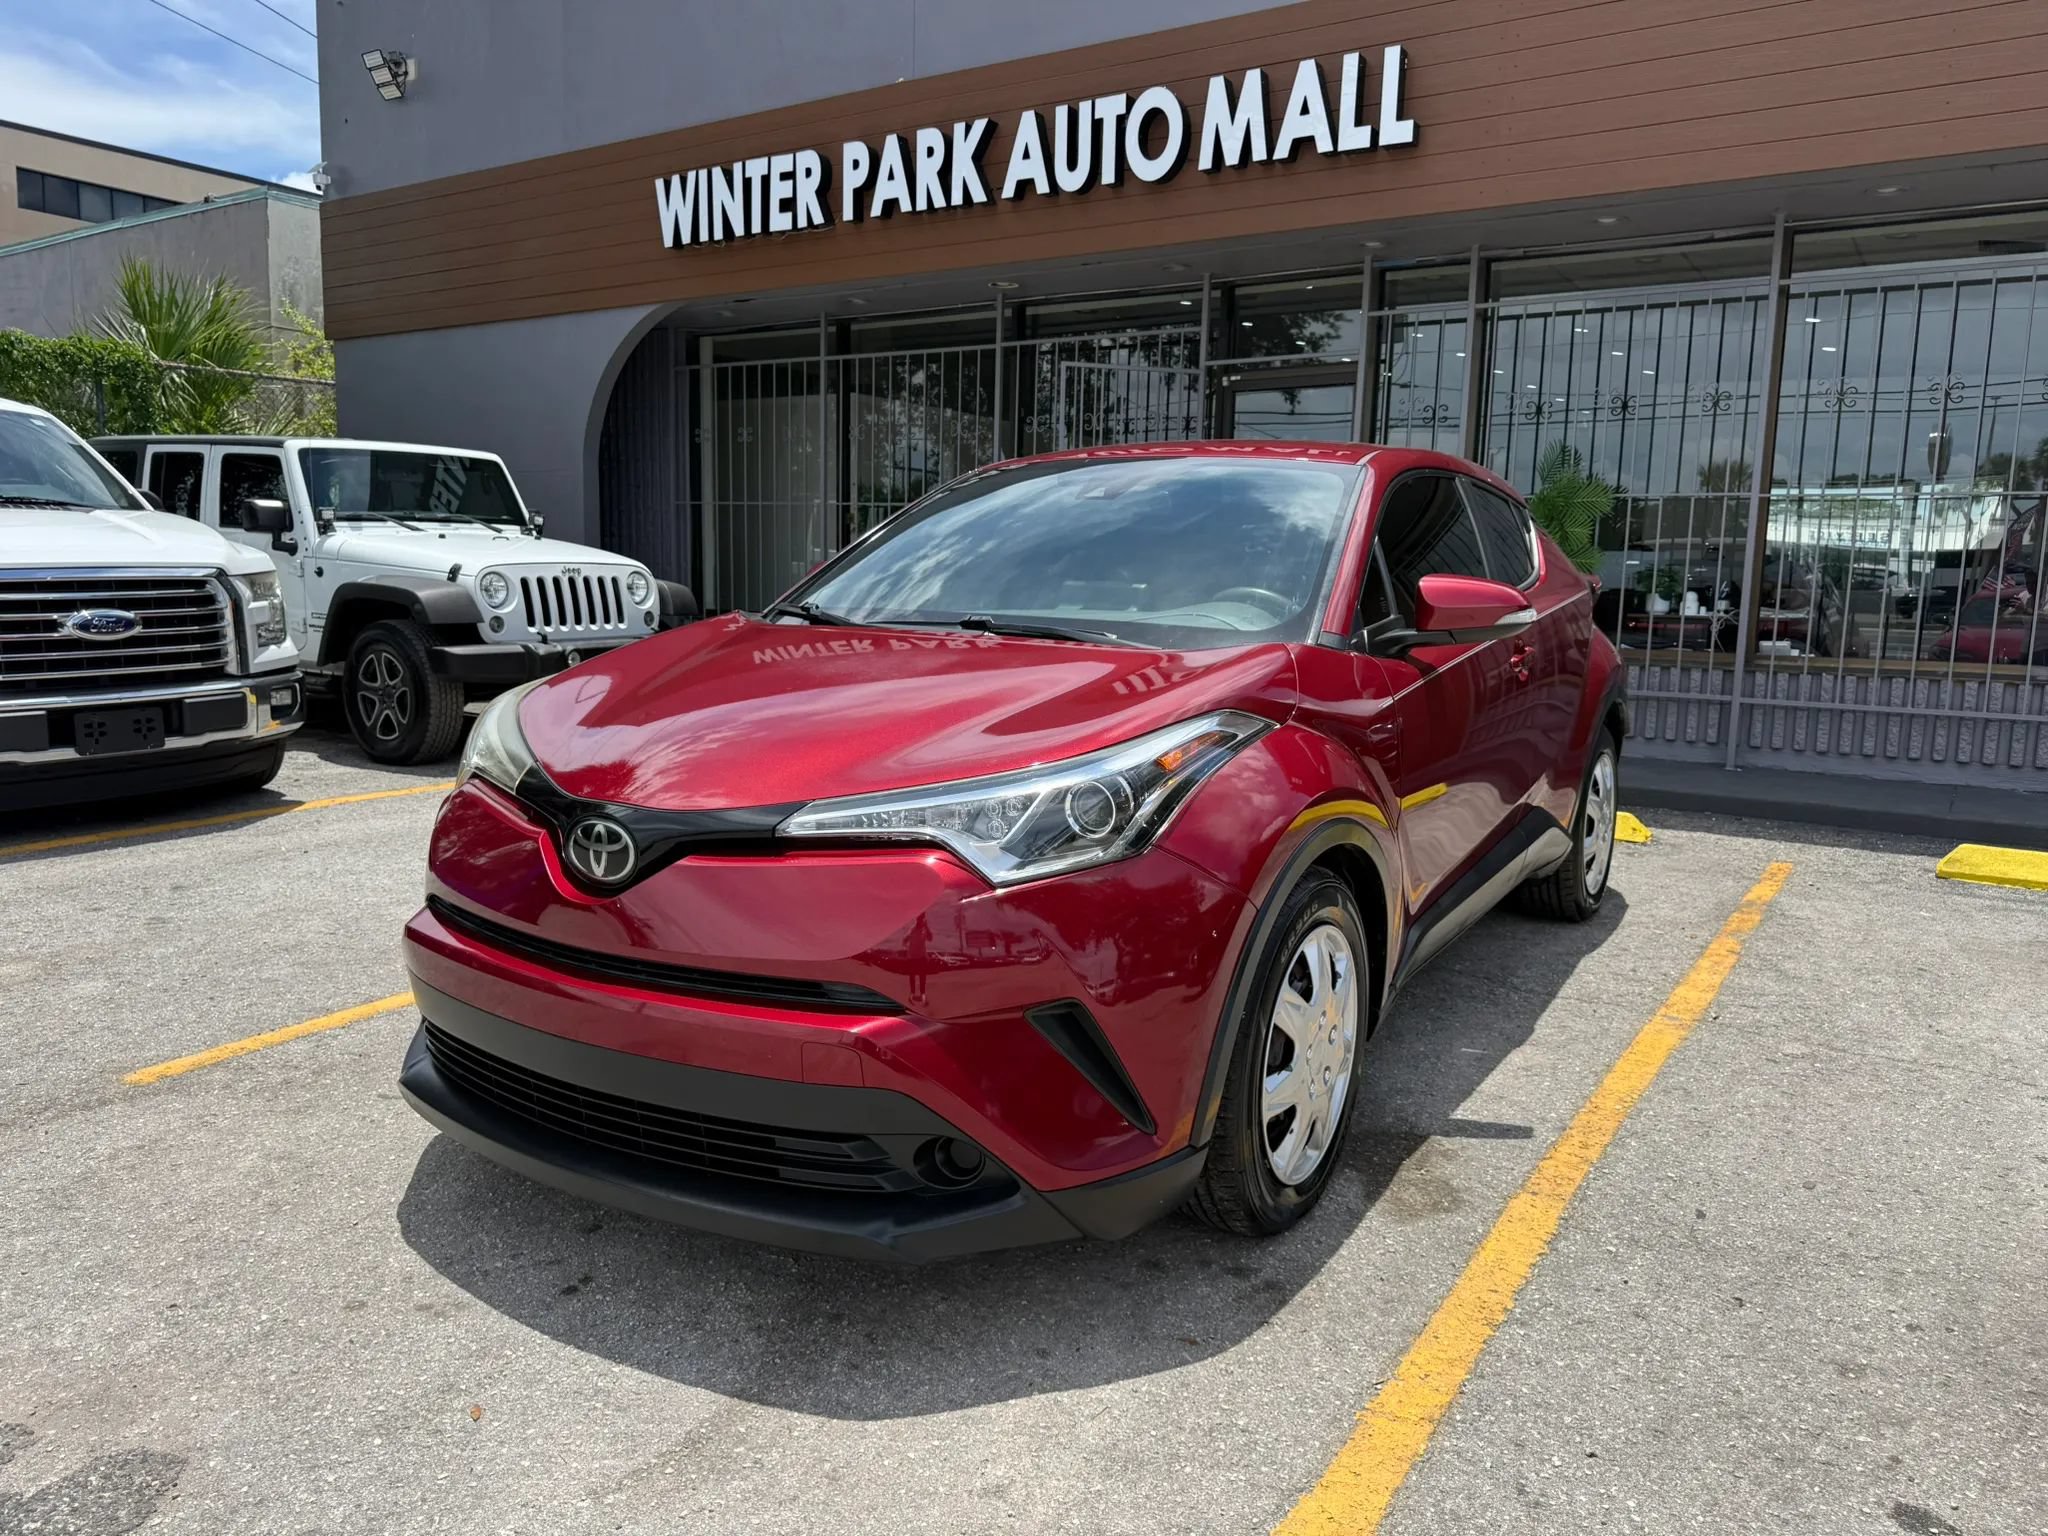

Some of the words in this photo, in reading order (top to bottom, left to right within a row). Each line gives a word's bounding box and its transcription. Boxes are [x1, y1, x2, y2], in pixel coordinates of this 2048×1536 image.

[655, 150, 825, 249] WINTER
[842, 117, 995, 222] PARK
[1001, 86, 1186, 199] AUTO
[1198, 45, 1416, 171] MALL
[561, 565, 582, 577] Jeep
